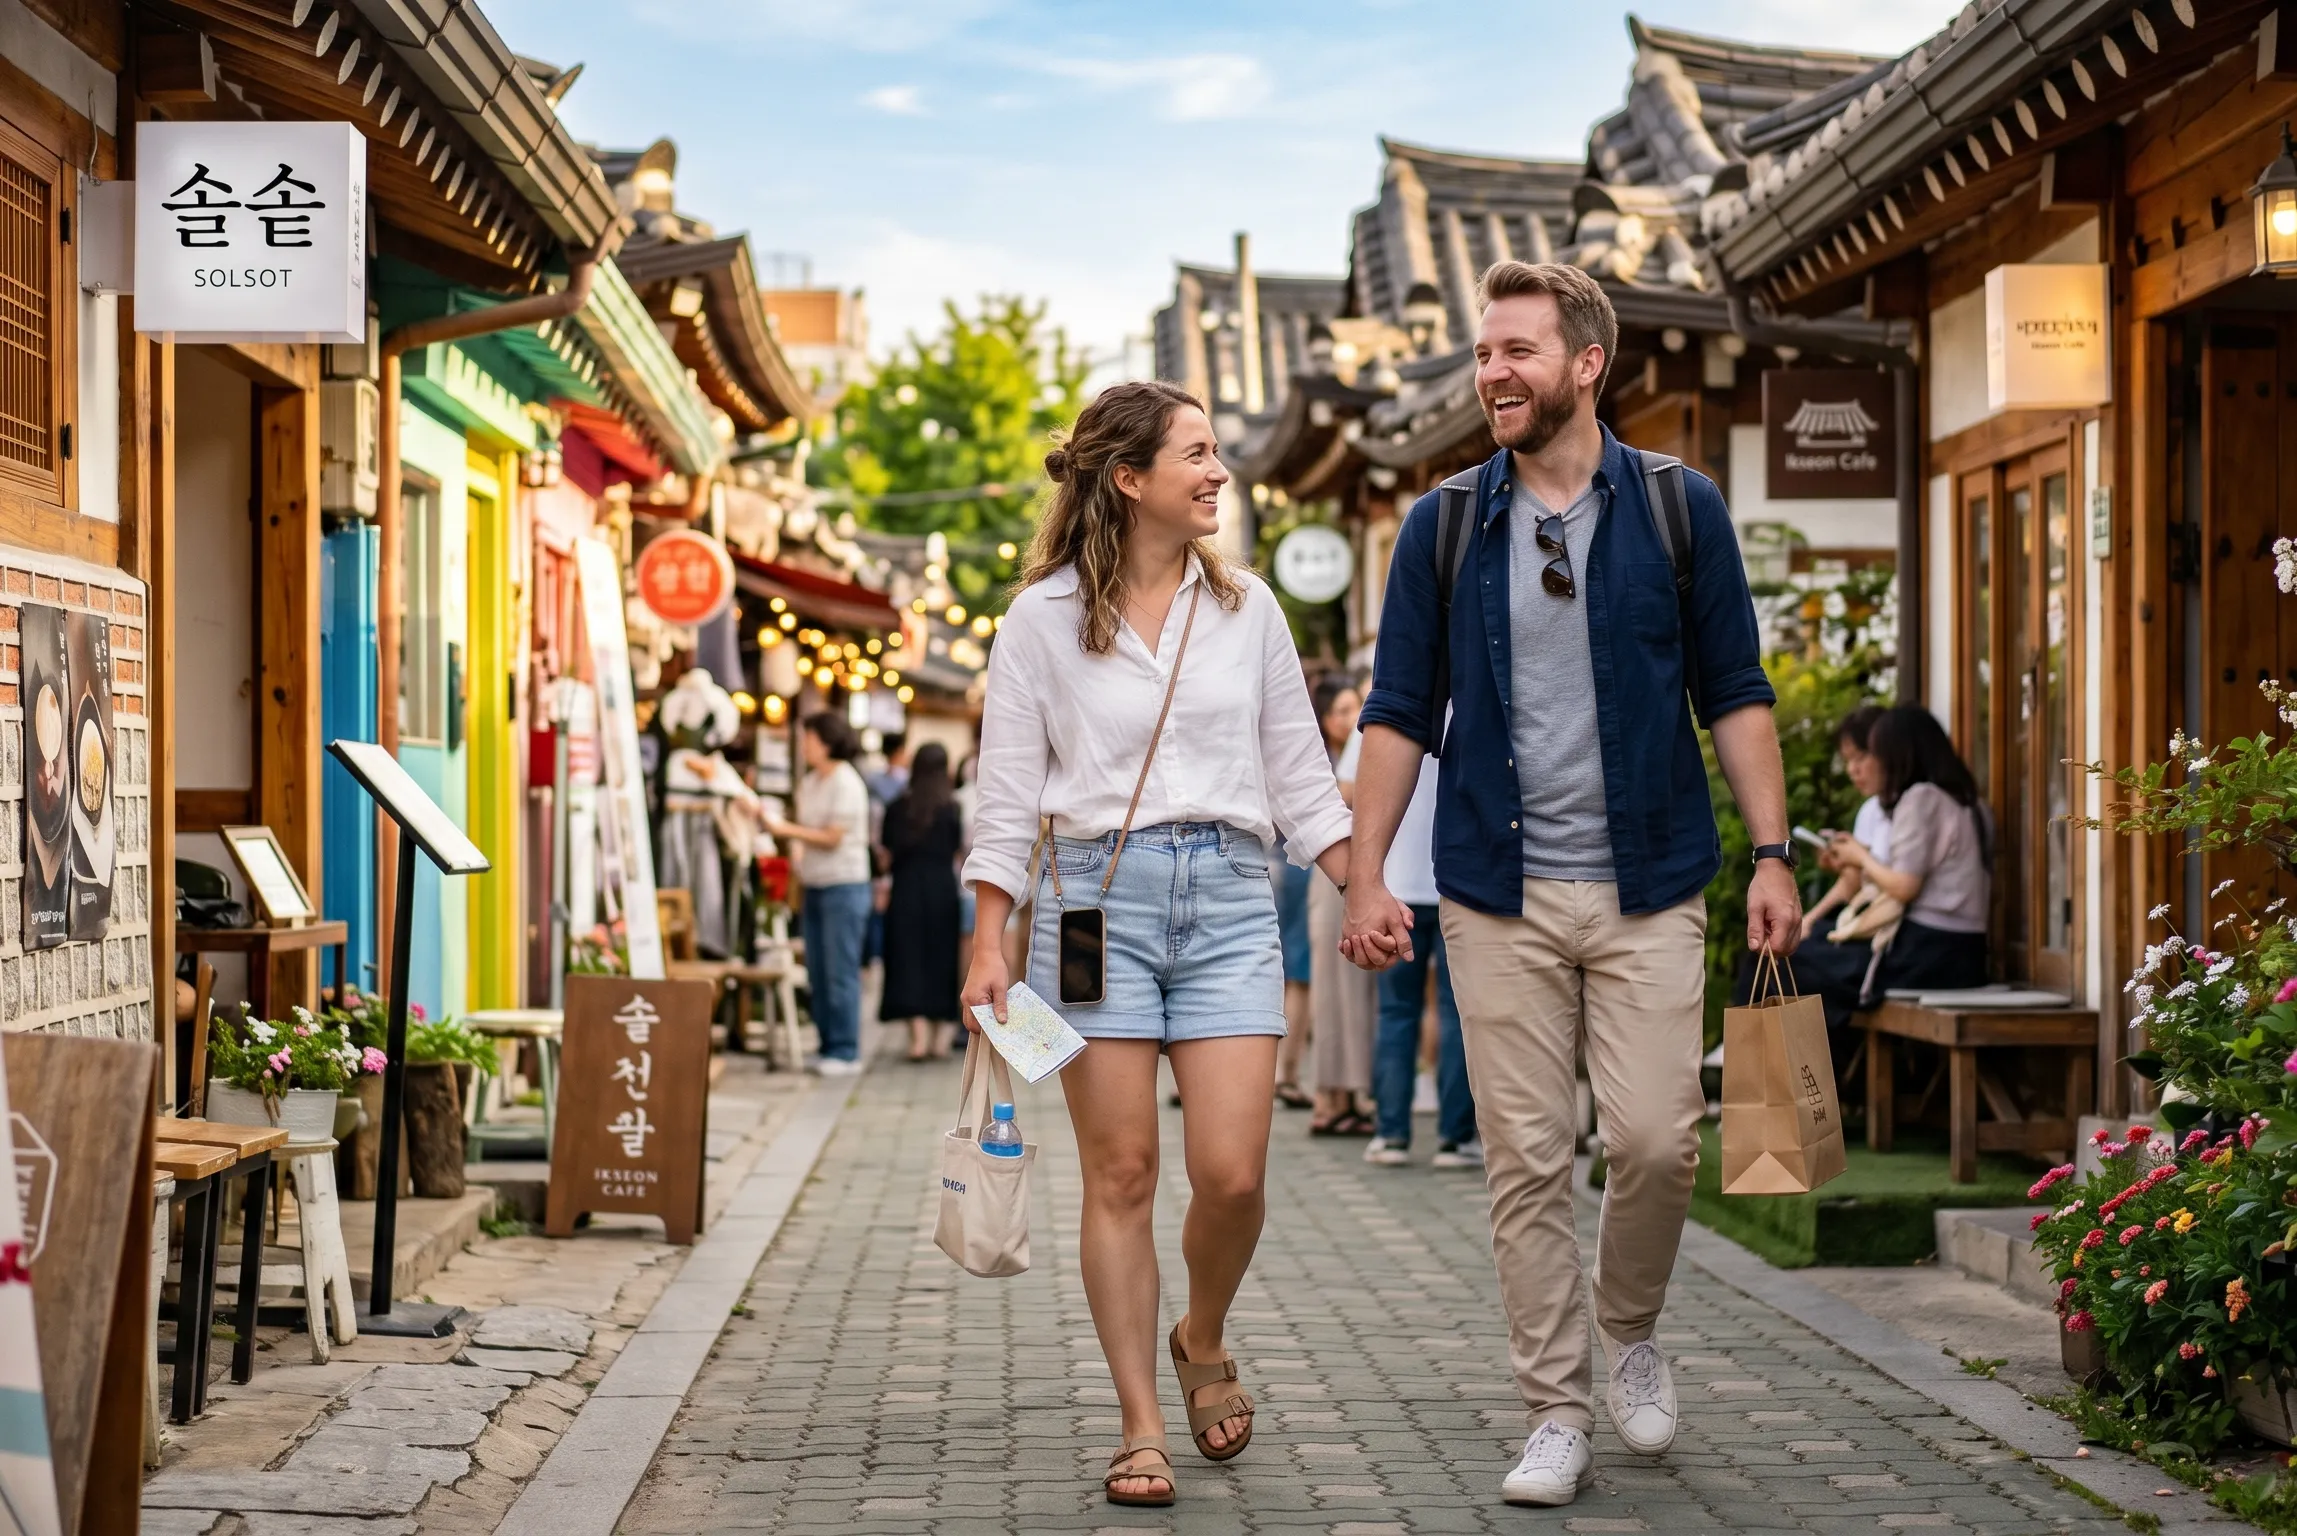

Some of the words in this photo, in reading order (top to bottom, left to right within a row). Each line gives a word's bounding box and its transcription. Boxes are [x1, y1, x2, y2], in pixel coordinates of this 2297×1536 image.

[161, 162, 326, 248] 솔솥
[194, 268, 293, 288] SOLSOT
[1839, 450, 1877, 471] Cafe
[601, 1183, 646, 1198] CAFE
